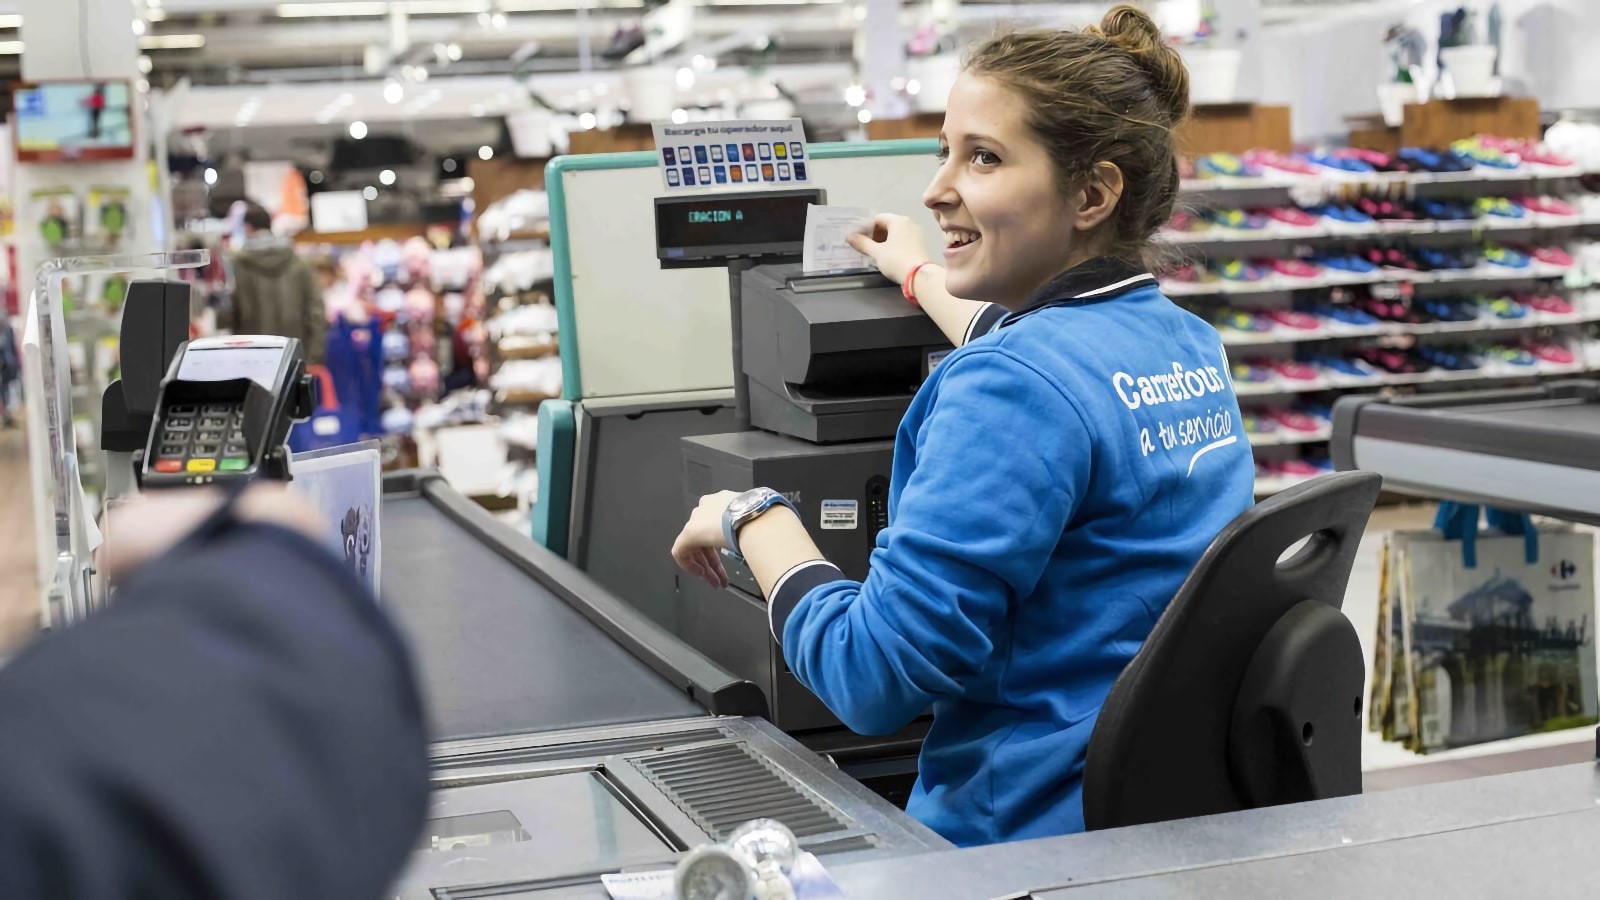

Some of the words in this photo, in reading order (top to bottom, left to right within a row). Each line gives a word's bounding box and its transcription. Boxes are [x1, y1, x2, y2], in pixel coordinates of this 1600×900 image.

[664, 128, 706, 136] Recarga
[708, 126, 719, 135] tu
[720, 124, 767, 135] operador
[1112, 361, 1225, 410] Carrefour
[1140, 427, 1156, 457] a
[1158, 421, 1178, 450] tu
[1178, 406, 1232, 446] servicio
